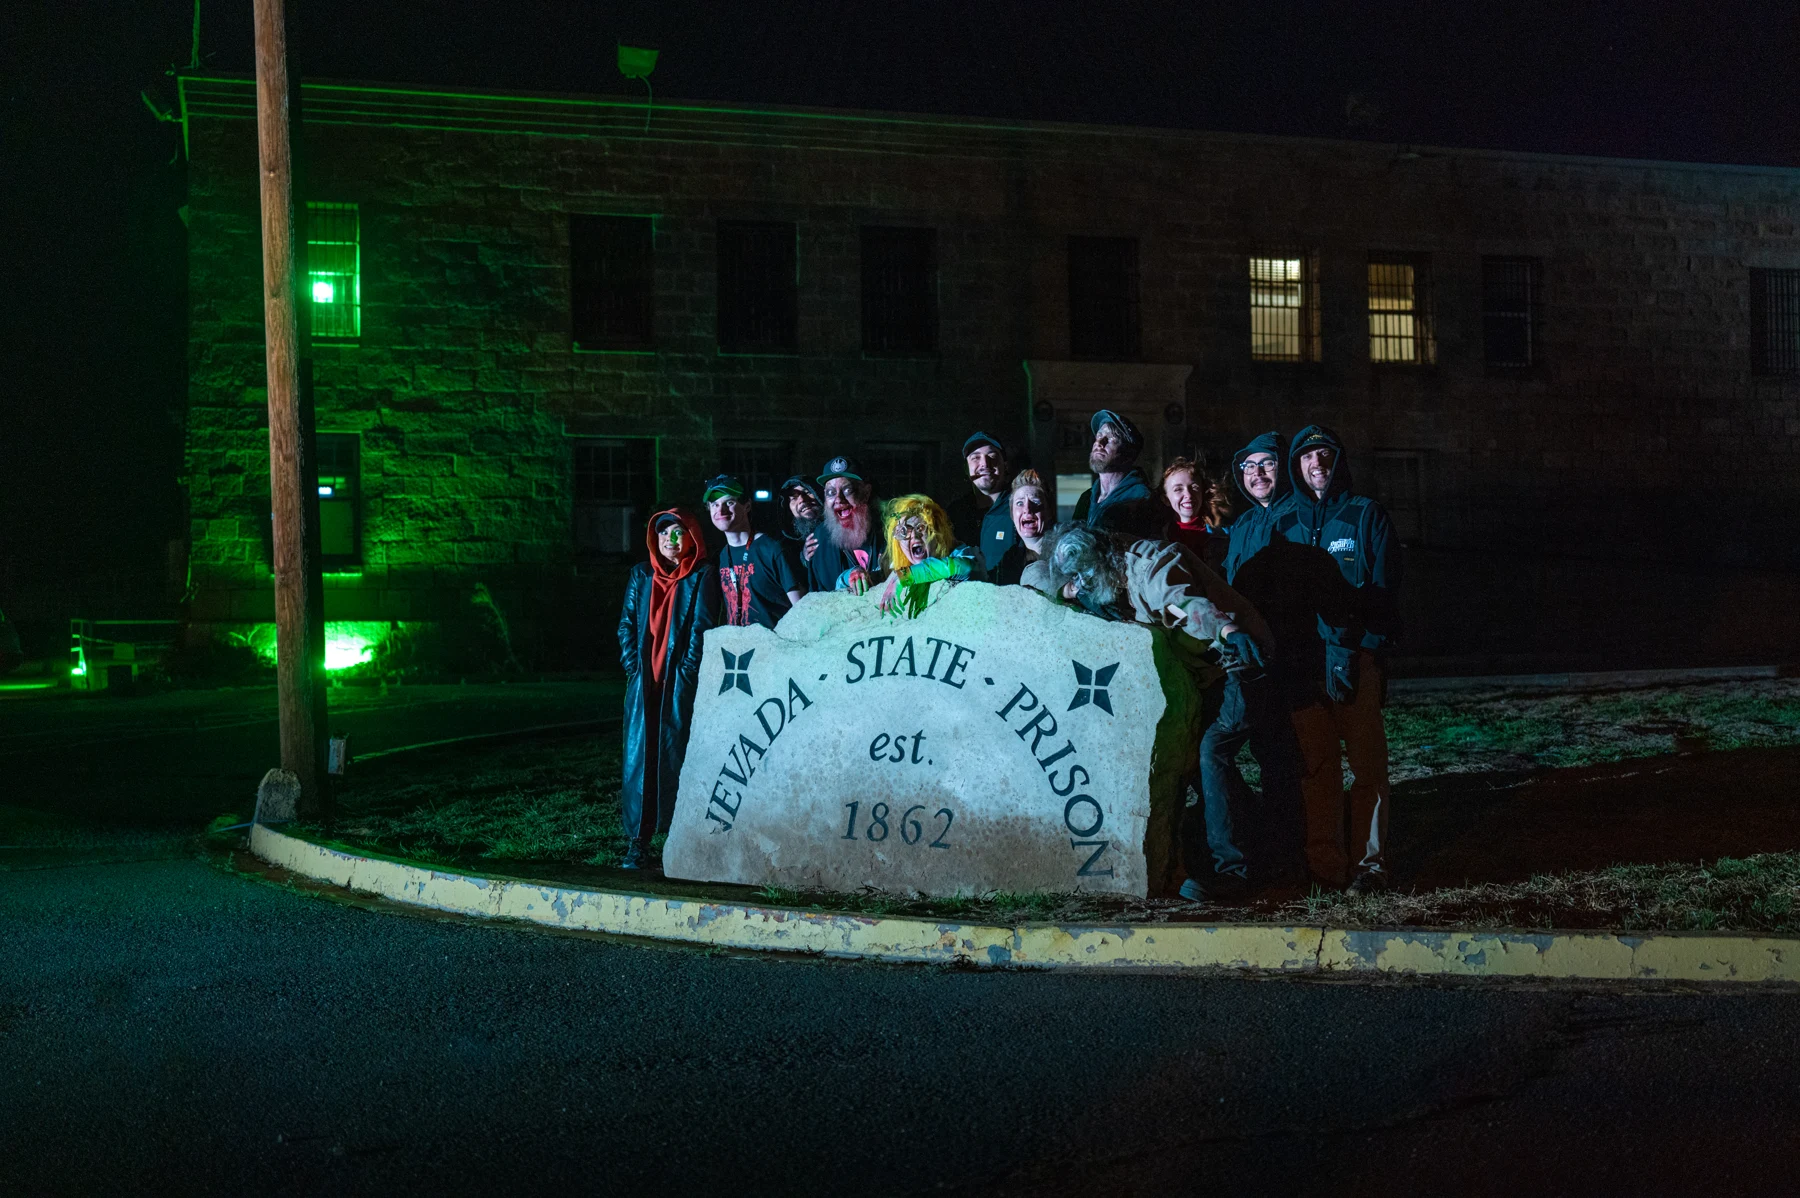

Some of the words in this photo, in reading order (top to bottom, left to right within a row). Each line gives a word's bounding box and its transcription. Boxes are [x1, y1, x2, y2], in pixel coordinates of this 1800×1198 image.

[846, 635, 976, 690] STATE
[995, 682, 1114, 880] PRISON
[869, 730, 933, 766] est.
[841, 801, 954, 850] 1862
